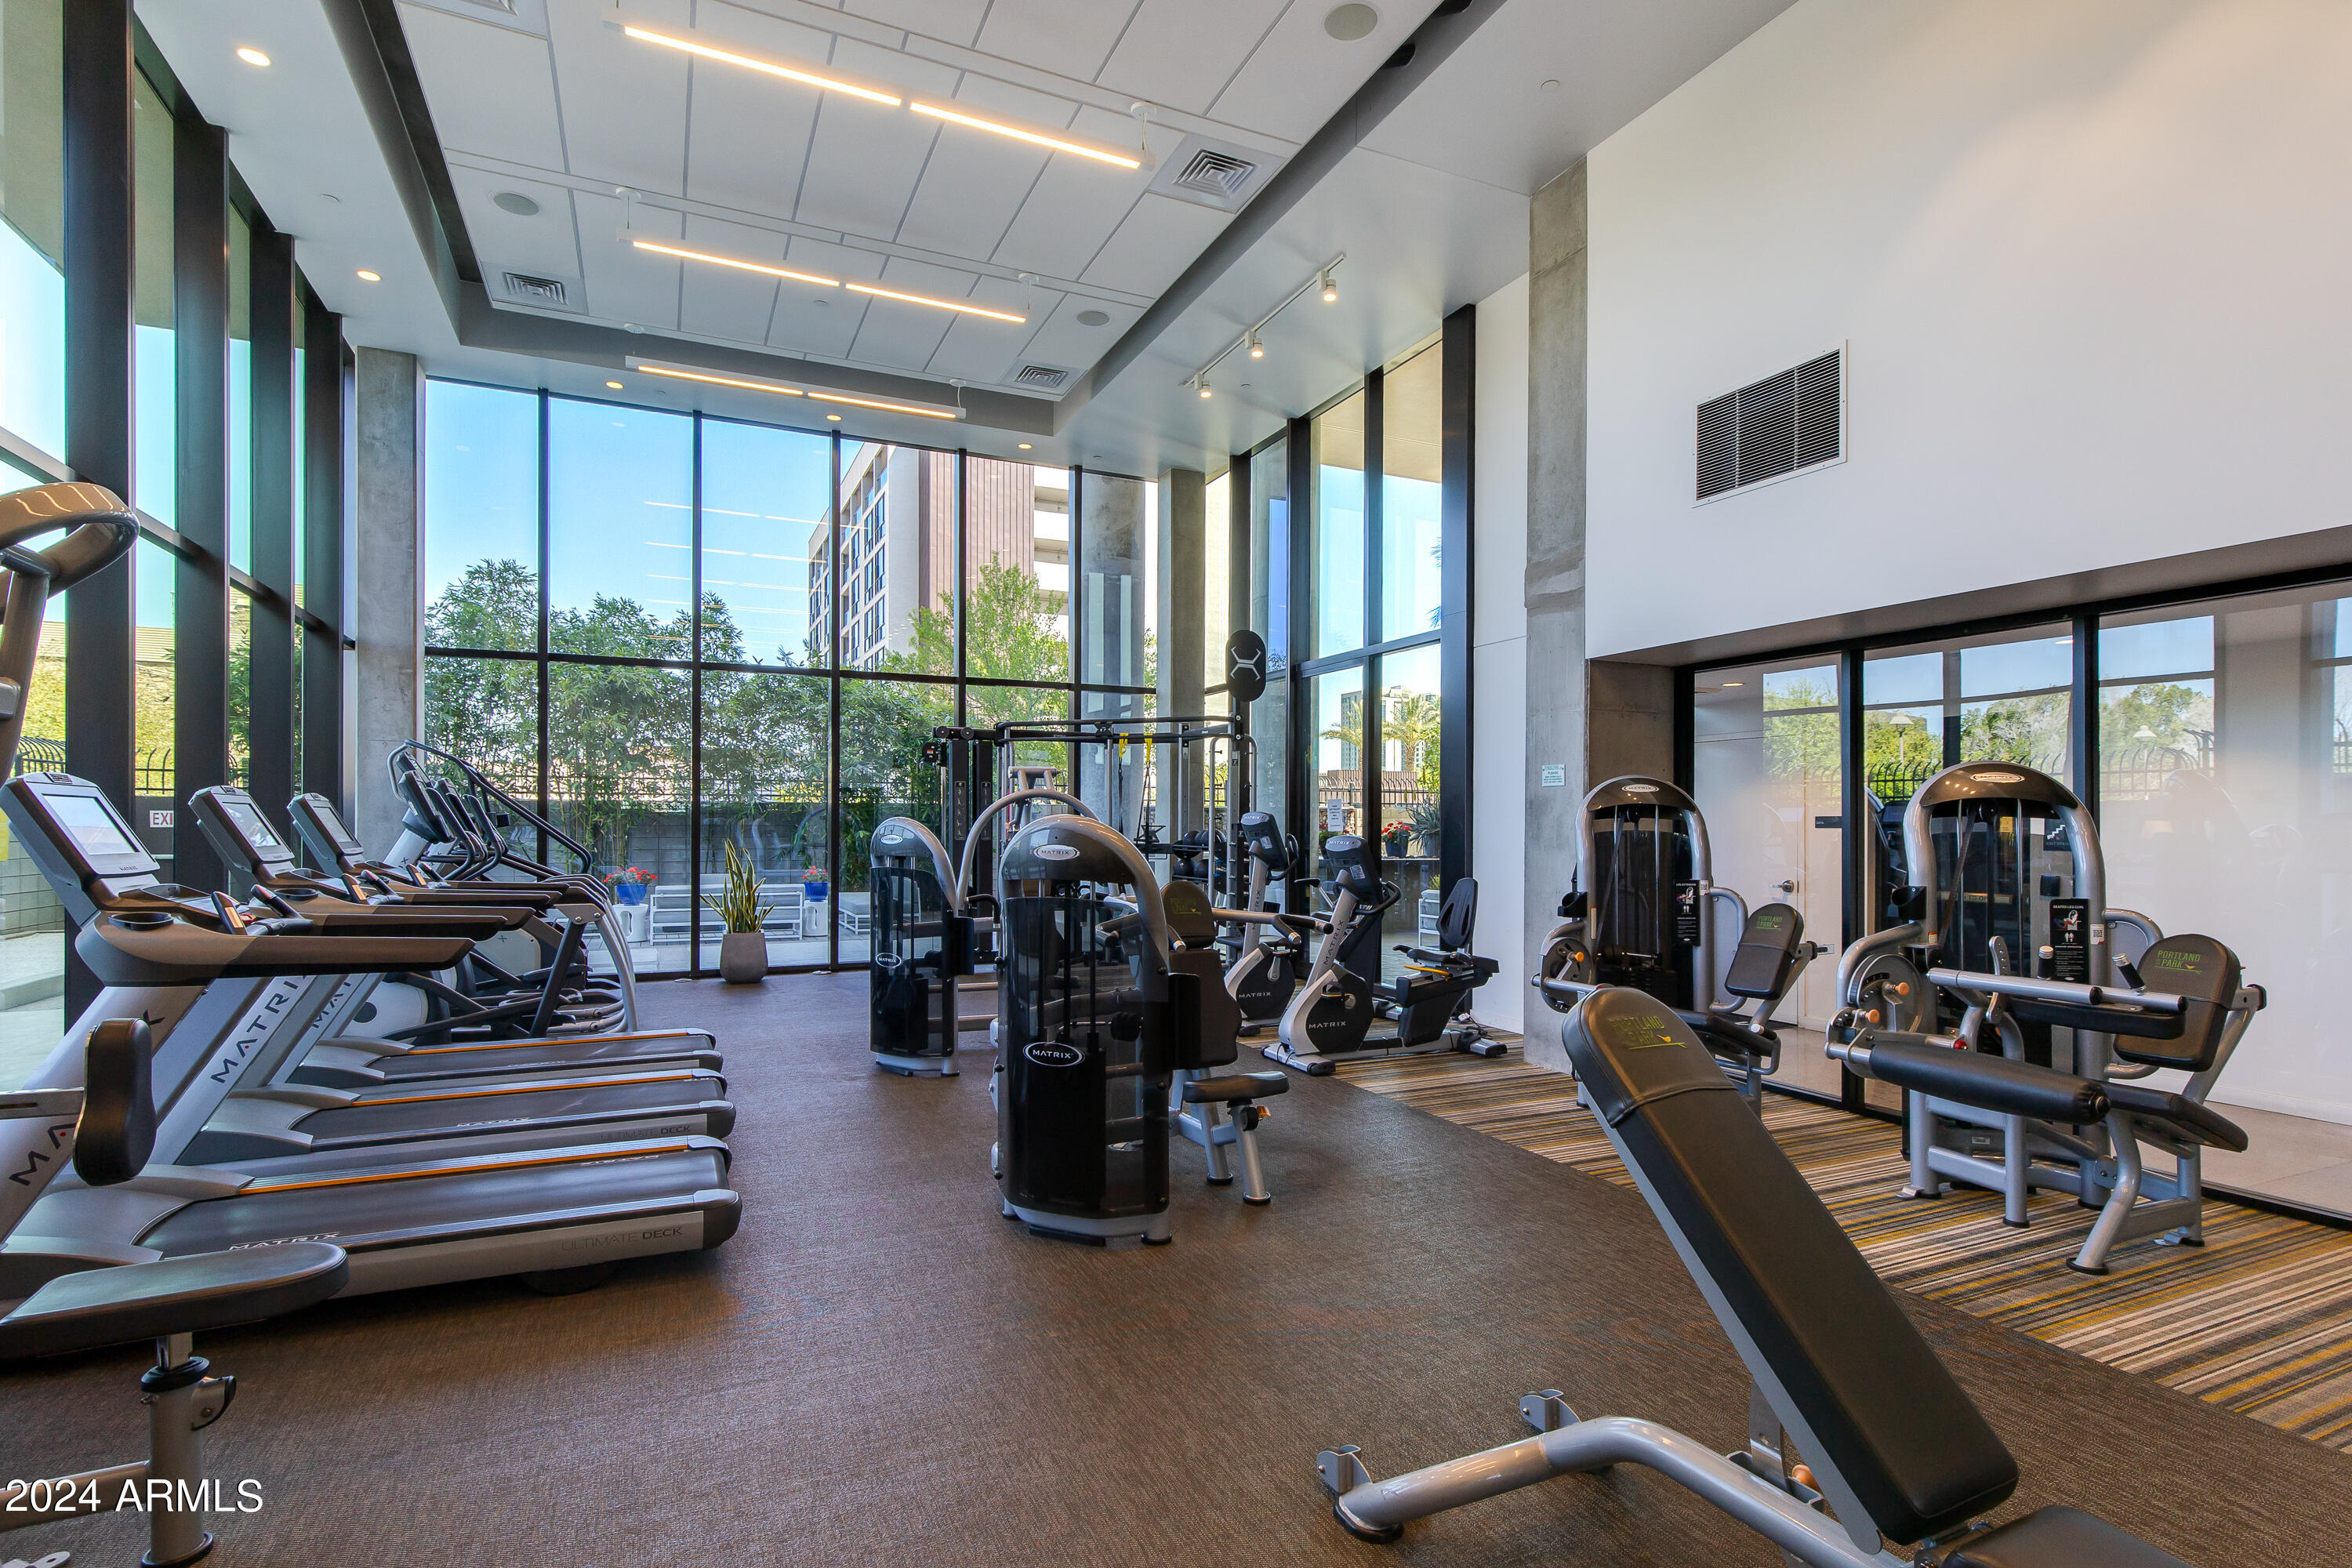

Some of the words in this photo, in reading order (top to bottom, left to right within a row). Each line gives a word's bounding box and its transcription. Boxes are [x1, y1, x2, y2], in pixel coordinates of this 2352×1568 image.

[152, 812, 173, 826] EXI
[1323, 920, 1343, 965] MATRIX
[2157, 949, 2201, 962] PORTLAND
[2161, 958, 2183, 968] PARK
[210, 975, 307, 1083] MATRI
[1033, 1050, 1072, 1059] MATRIX
[660, 1125, 690, 1135] DECK
[229, 1232, 340, 1250] MATRIX
[561, 1232, 641, 1251] ULTIMATE
[642, 1226, 684, 1240] DECK
